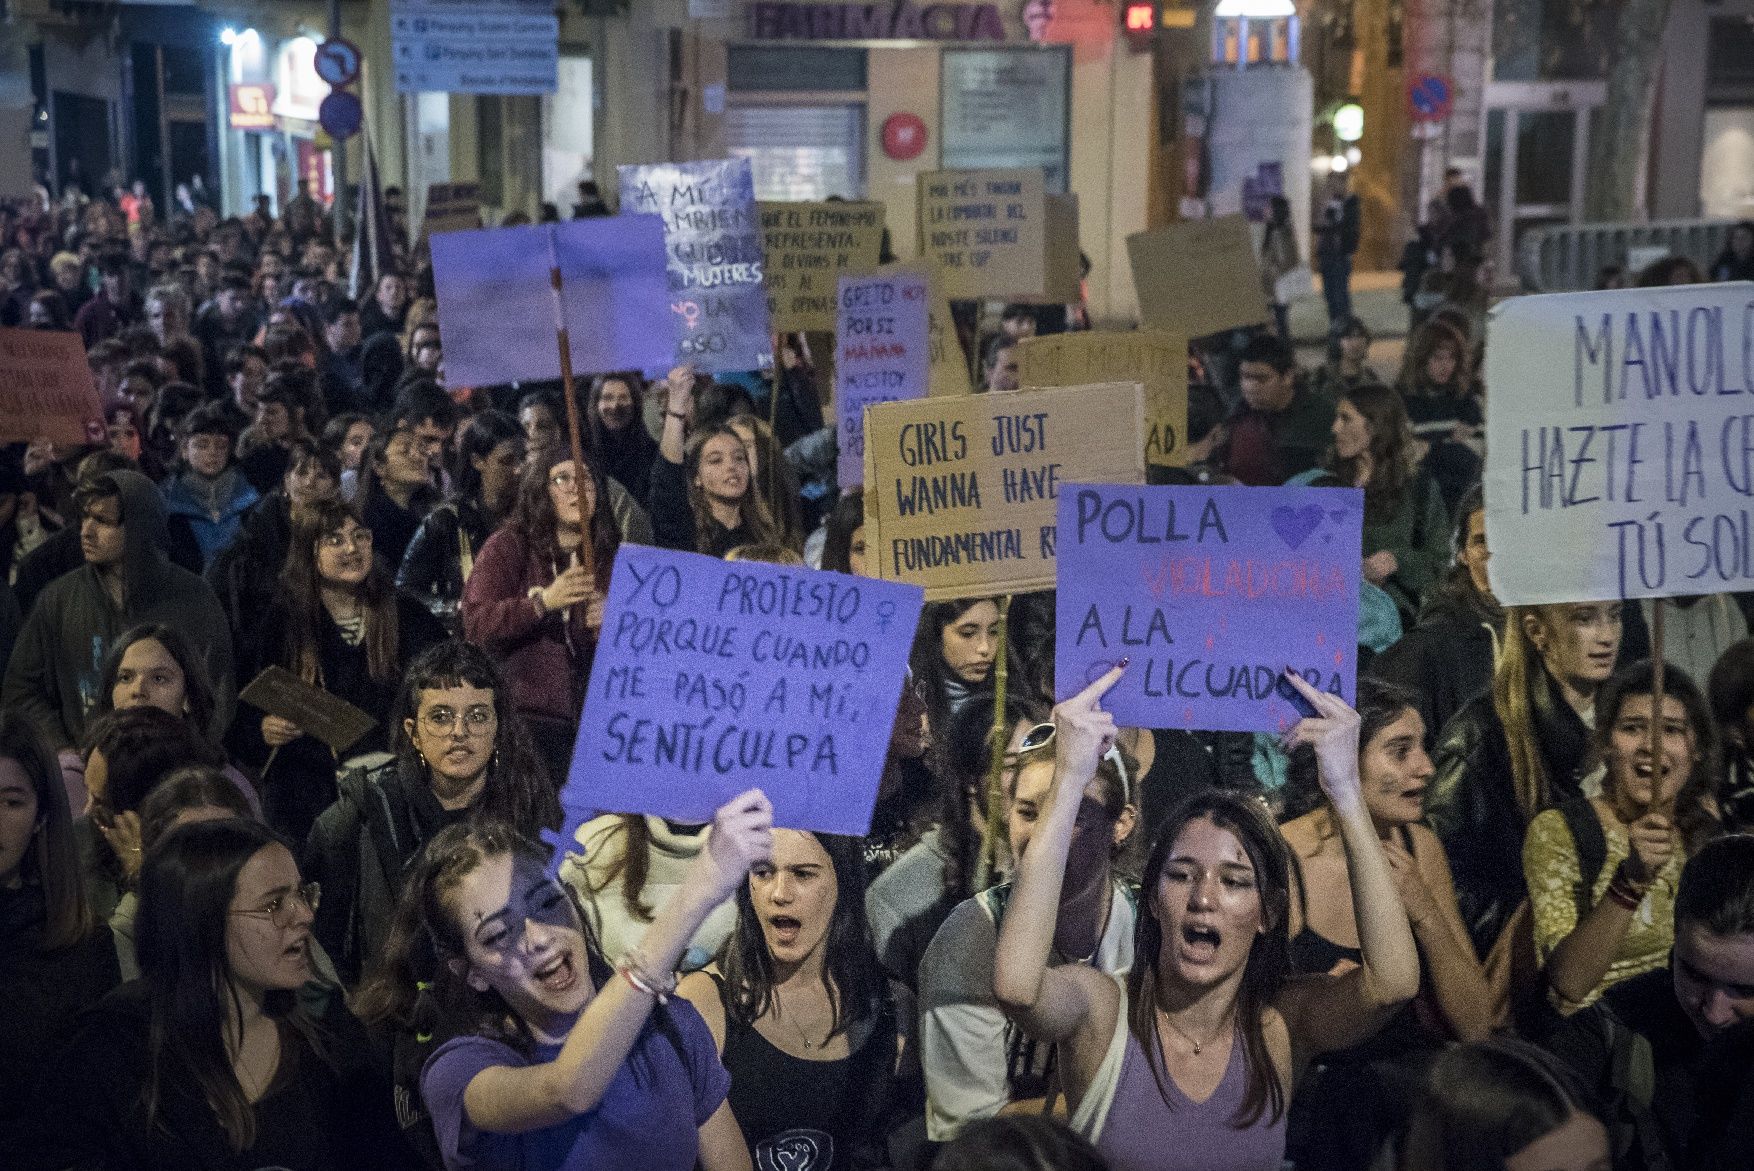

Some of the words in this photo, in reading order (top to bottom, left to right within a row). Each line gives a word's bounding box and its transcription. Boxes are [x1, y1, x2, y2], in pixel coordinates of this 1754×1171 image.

[640, 180, 658, 207] A
[683, 261, 763, 288] MUJERES
[900, 420, 967, 467] GIRLS
[991, 413, 1048, 457] JUST
[1148, 424, 1175, 455] AD
[1521, 422, 1649, 514] HAZTE
[1664, 420, 1706, 507] LA
[1721, 415, 1754, 497] CE
[895, 470, 982, 516] WANNA
[1002, 464, 1062, 504] HAVE
[1076, 489, 1229, 545] POLLA
[892, 527, 1026, 576] FUNDAMENTAL
[1608, 510, 1666, 600] TÚ
[1684, 510, 1754, 582] SOL
[624, 562, 682, 609] YO
[718, 572, 861, 625] PROTESTO
[1142, 553, 1347, 602] VIOLADORA
[613, 610, 737, 657] PORQUE
[752, 630, 870, 672] CUANDO
[1076, 602, 1107, 648] A
[1121, 605, 1174, 646] LA
[605, 666, 646, 700] ME
[674, 671, 750, 716] PASÓ
[764, 677, 788, 715] A
[713, 726, 839, 776] CULPA
